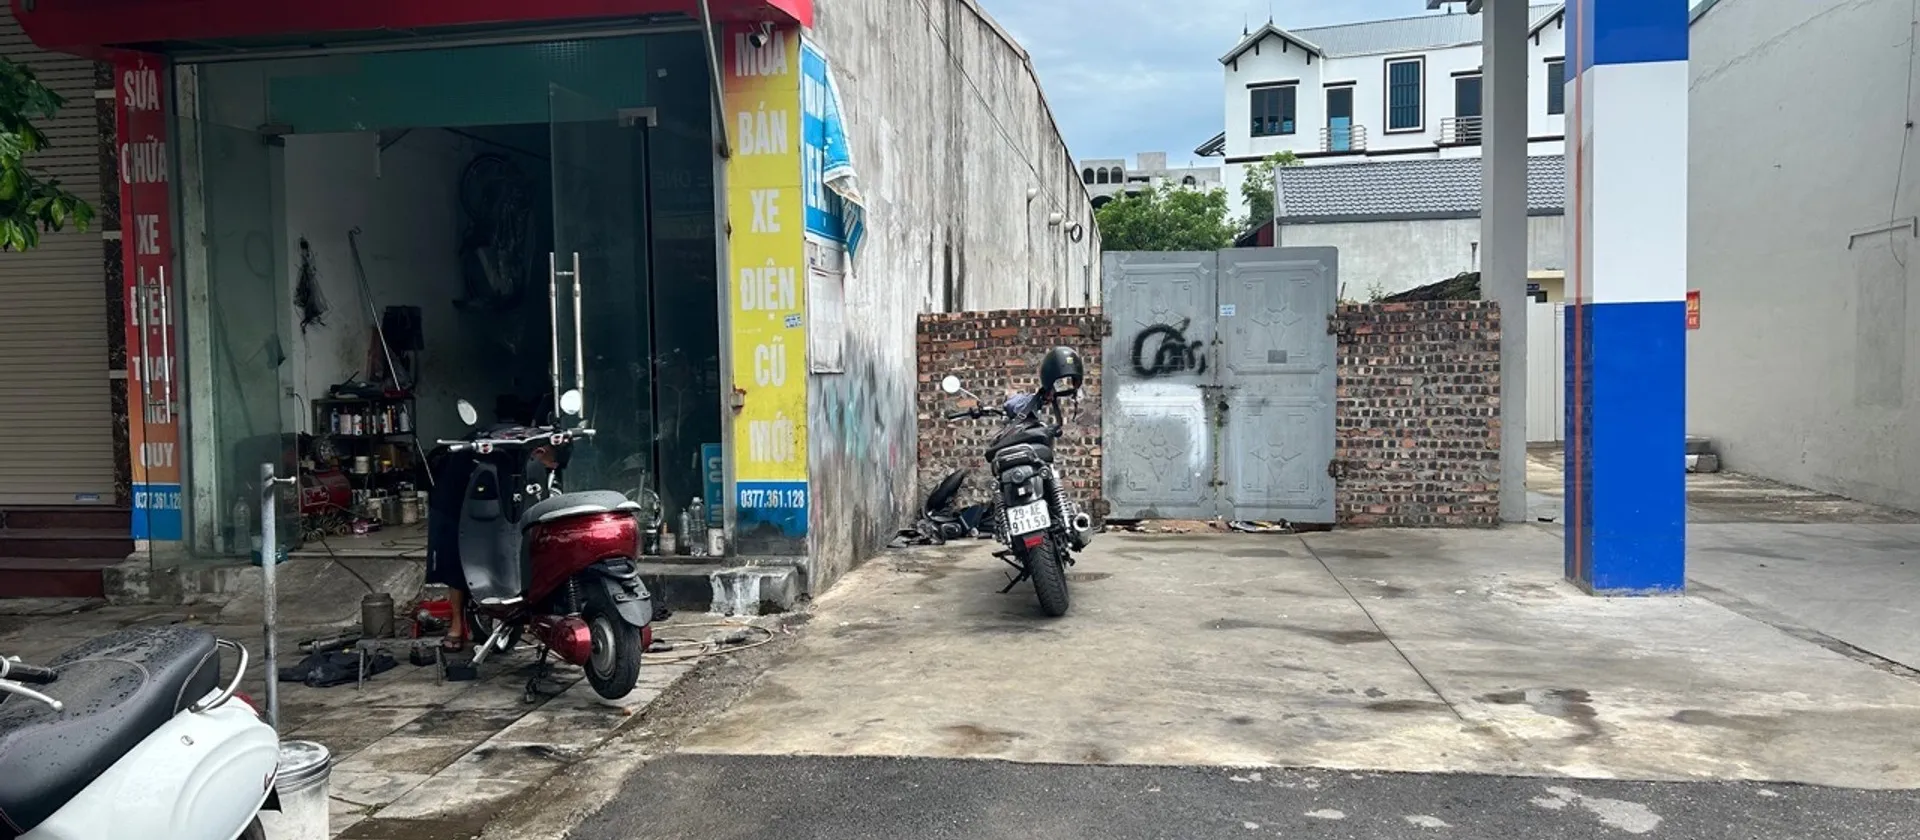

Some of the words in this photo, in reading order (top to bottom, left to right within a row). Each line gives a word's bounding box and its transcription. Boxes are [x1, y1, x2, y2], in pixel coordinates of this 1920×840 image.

[735, 30, 788, 77] MUA
[124, 60, 160, 111] SỬA
[738, 101, 788, 156] BÁN
[121, 134, 170, 184] CHỮA
[137, 214, 160, 254] XE
[751, 189, 781, 234] XE
[739, 258, 796, 321] ĐIỆN
[755, 336, 786, 388] CŨ
[139, 442, 174, 469] QUY
[749, 411, 795, 463] MỚI
[740, 489, 805, 509] 0377.361.128
[1012, 514, 1047, 534] 911.59
